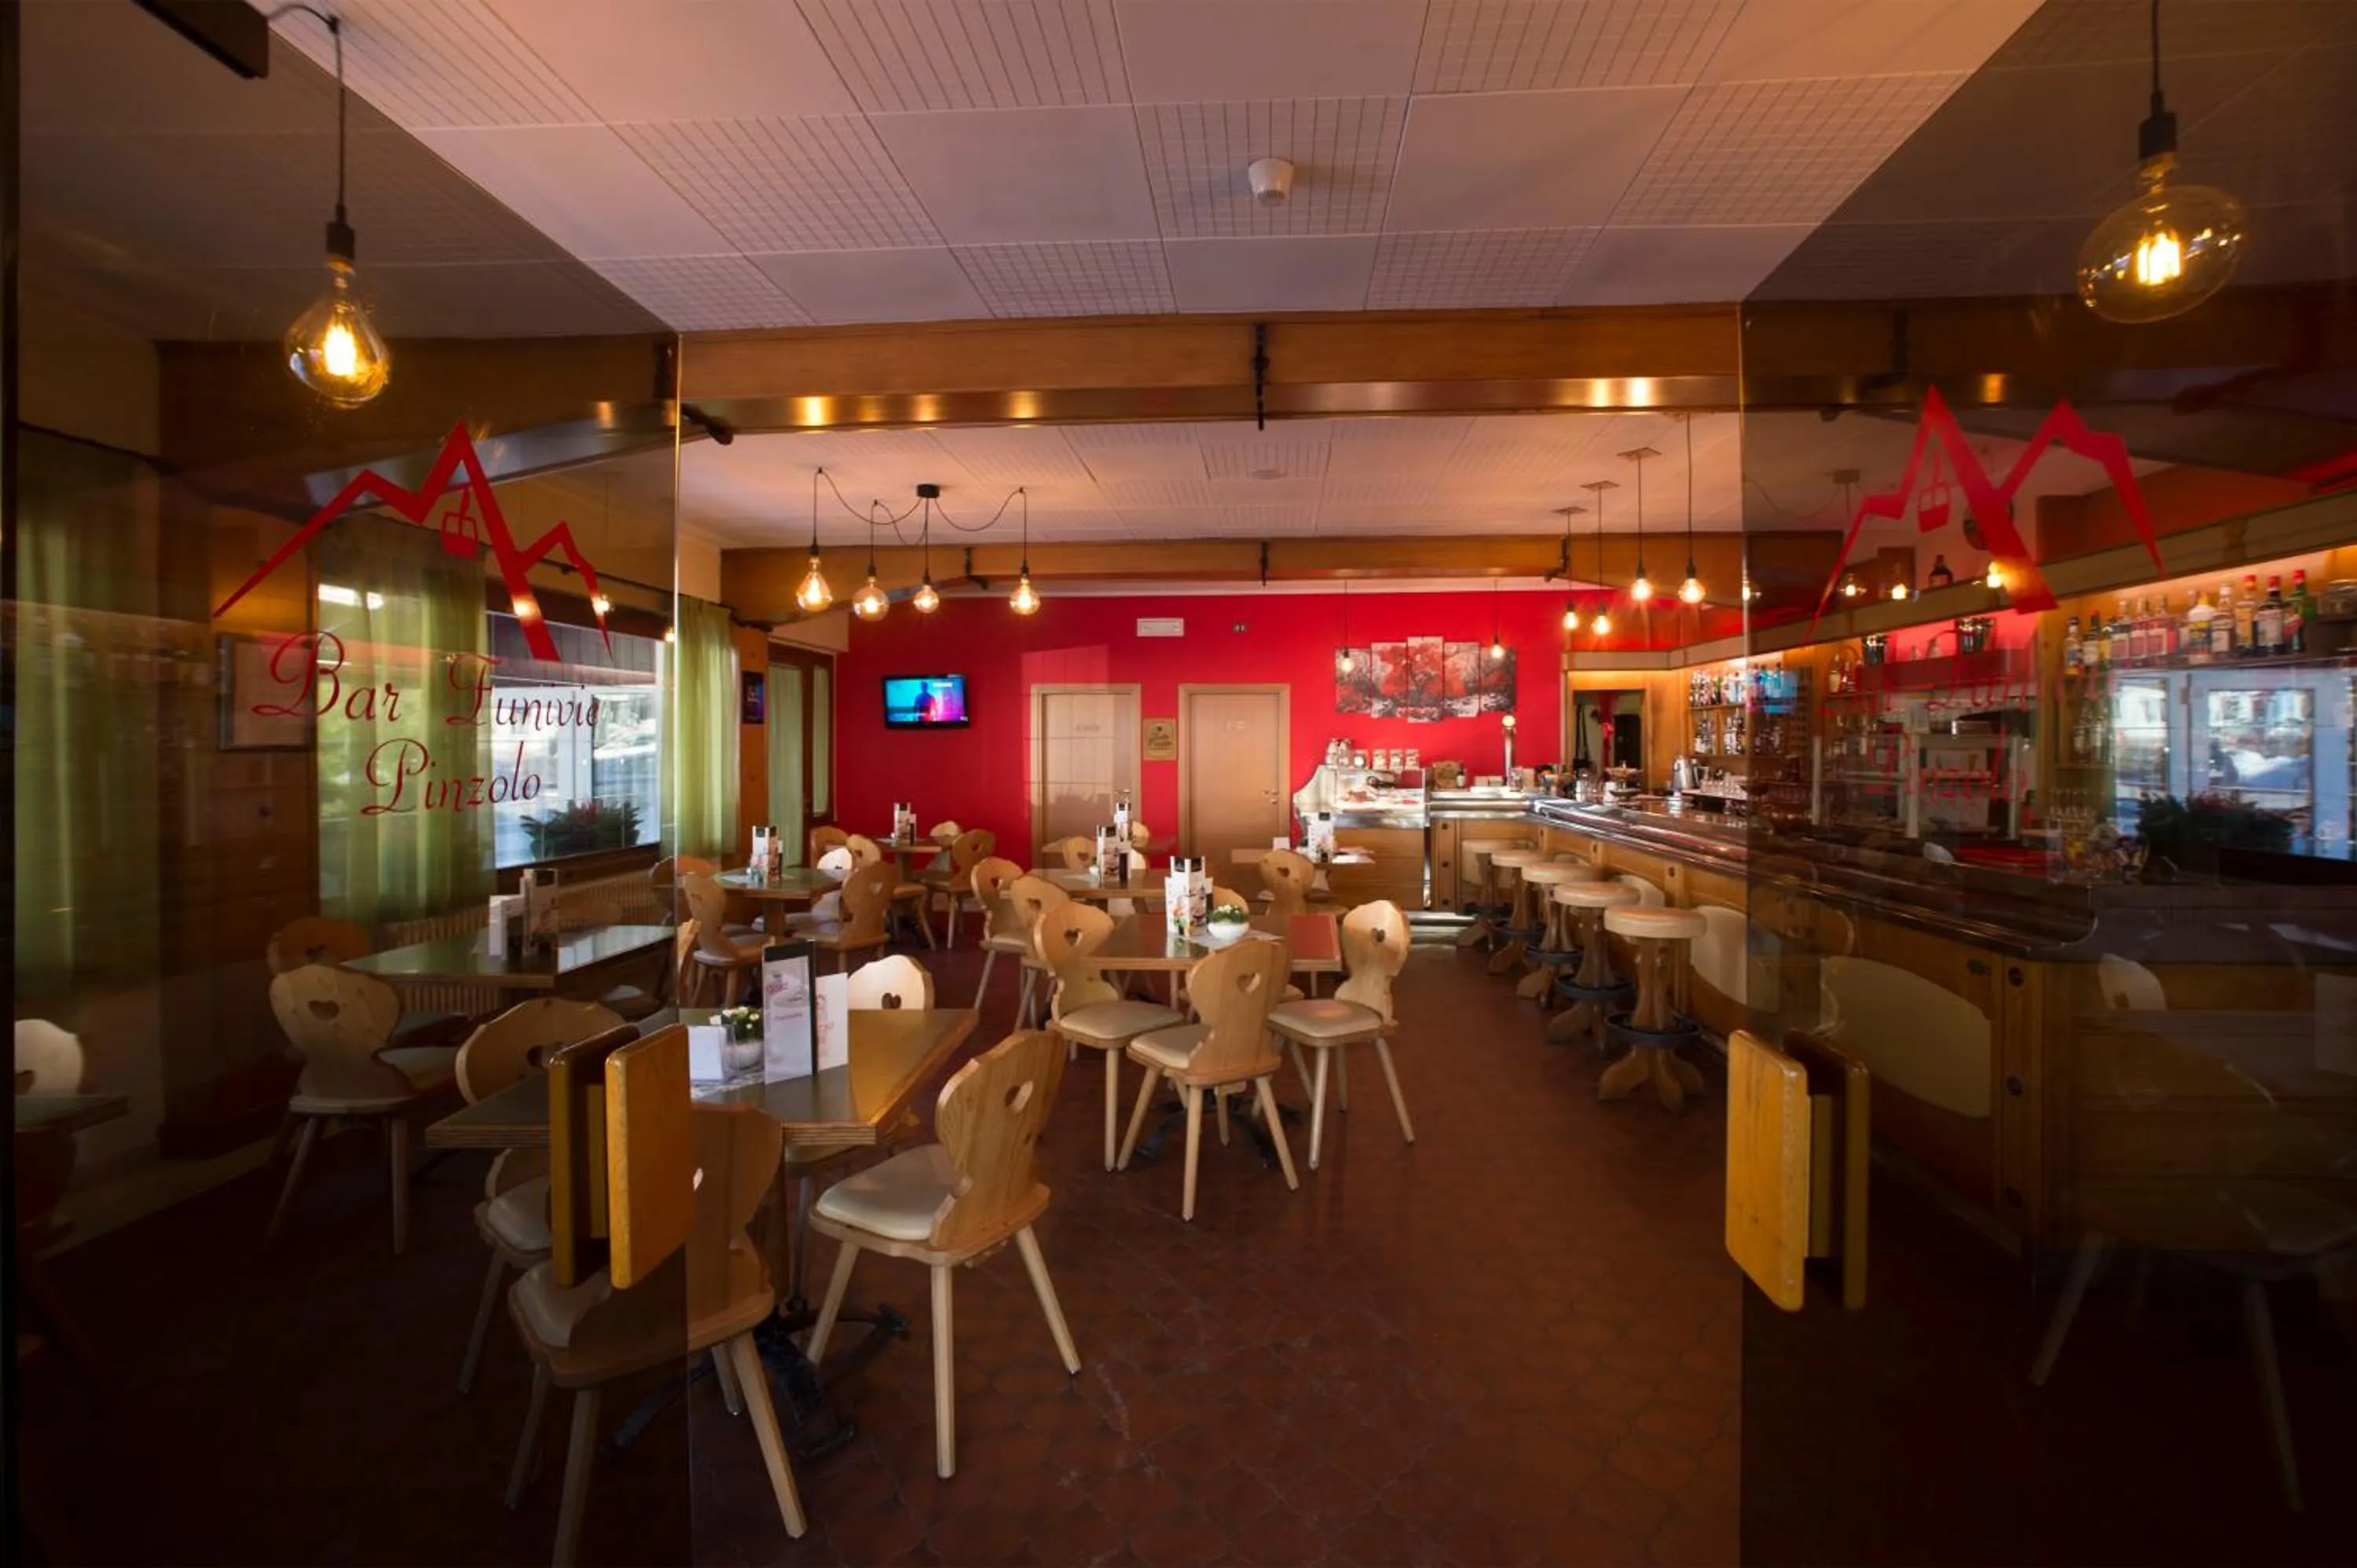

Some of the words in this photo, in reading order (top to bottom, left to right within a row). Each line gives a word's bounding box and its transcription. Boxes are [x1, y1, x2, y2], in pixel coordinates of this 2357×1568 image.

[251, 631, 401, 721] Bar
[445, 654, 599, 731] Funivie
[361, 738, 541, 815] Pinzolo
